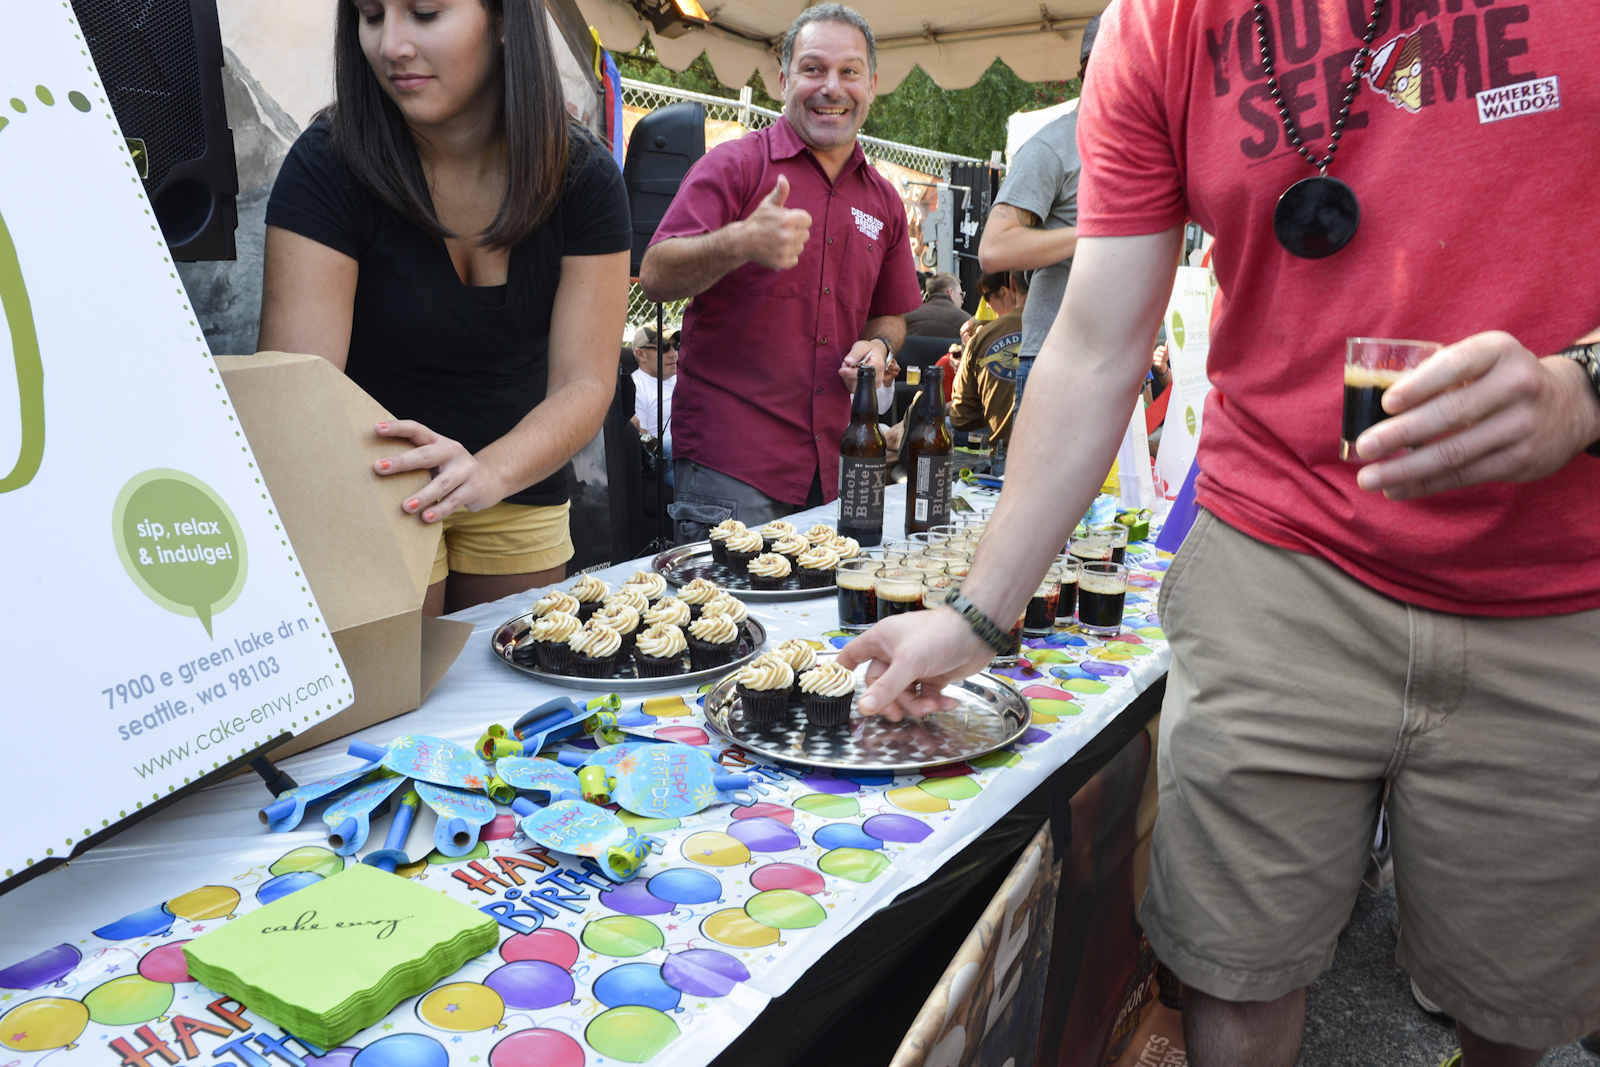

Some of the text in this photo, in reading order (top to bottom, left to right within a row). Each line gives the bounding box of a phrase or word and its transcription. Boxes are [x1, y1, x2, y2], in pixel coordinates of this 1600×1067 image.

[1206, 0, 1320, 97] YOU
[1238, 4, 1537, 159] SEE ME
[1481, 80, 1554, 106] WHERE'S
[1483, 93, 1558, 118] WALDO?
[992, 335, 1020, 353] DEAD
[843, 468, 856, 518] Black
[855, 469, 870, 518] Butte
[932, 467, 945, 516] Black
[136, 517, 222, 541] sip, relax
[138, 542, 233, 566] & indulge!
[101, 616, 311, 710] 7900 e green lake dr n
[117, 655, 281, 741] seattle, wa 98103
[132, 673, 335, 780] www.cake-envy.com
[261, 910, 329, 934] cake
